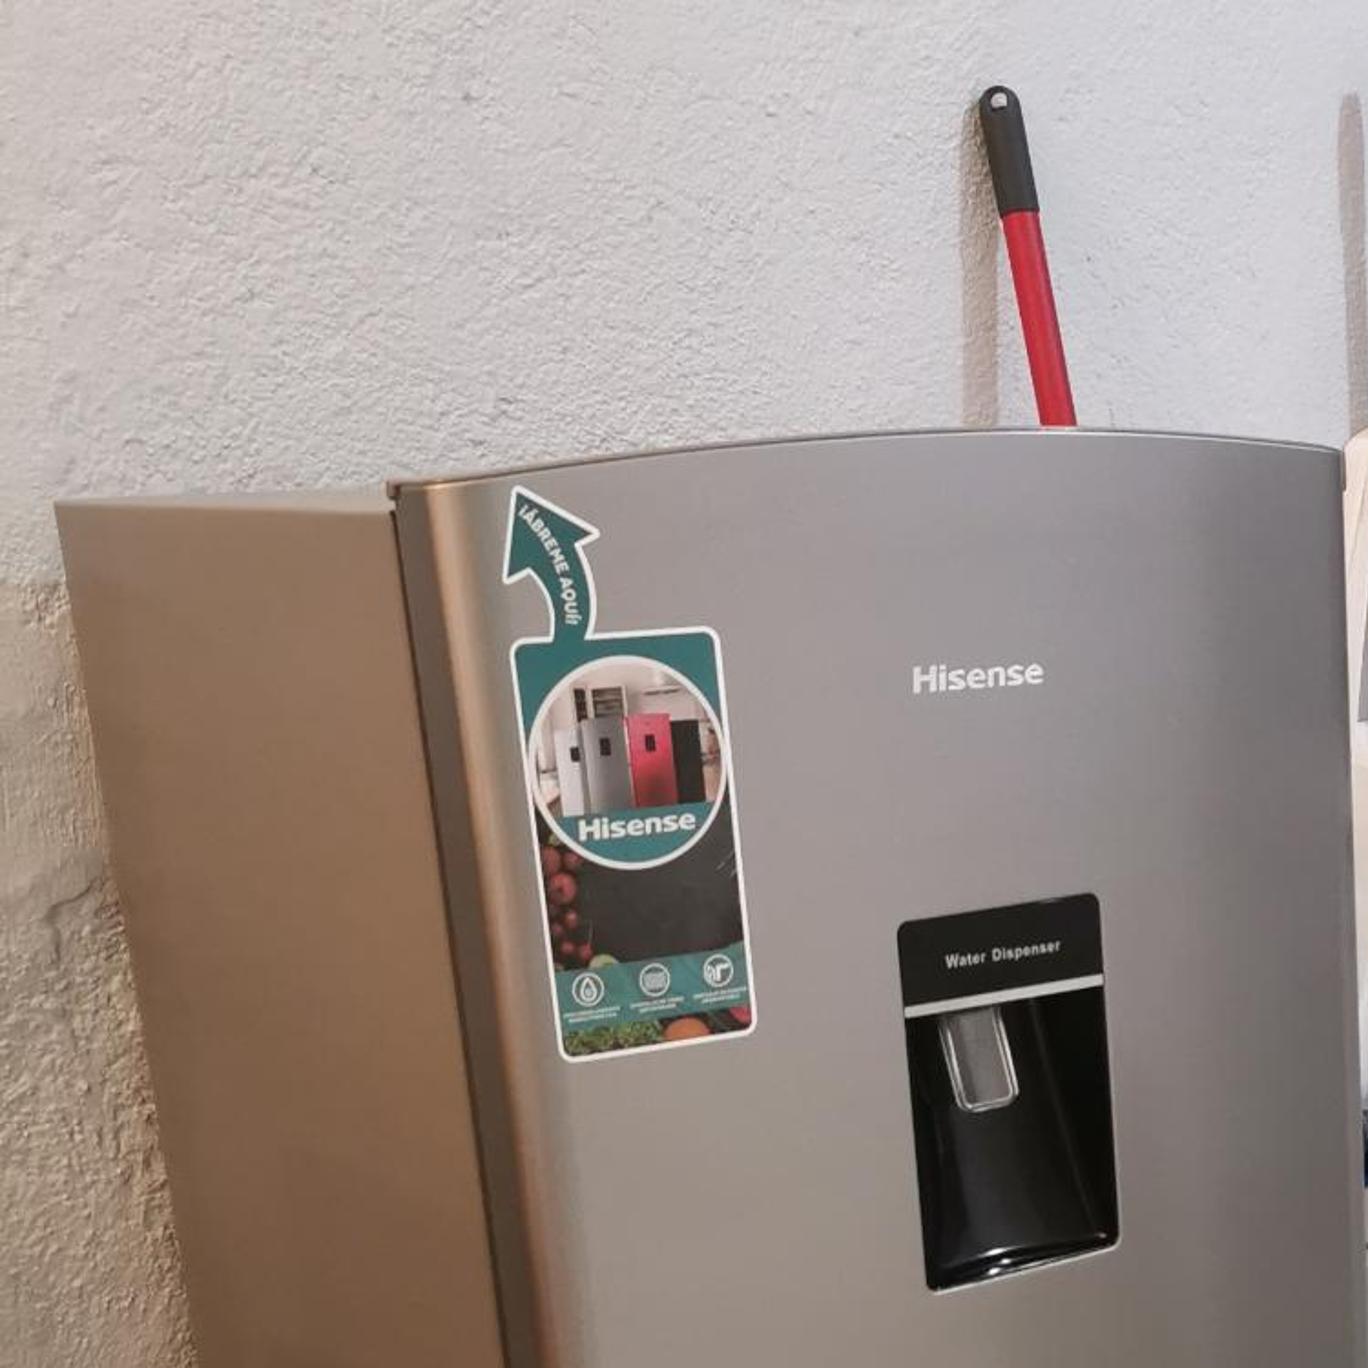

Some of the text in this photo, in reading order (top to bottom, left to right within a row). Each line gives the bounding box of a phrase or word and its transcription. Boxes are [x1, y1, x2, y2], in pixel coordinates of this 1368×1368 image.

[912, 662, 1044, 694] Hisense
[577, 812, 696, 842] Hisense
[945, 940, 1061, 969] Water Dispenser
